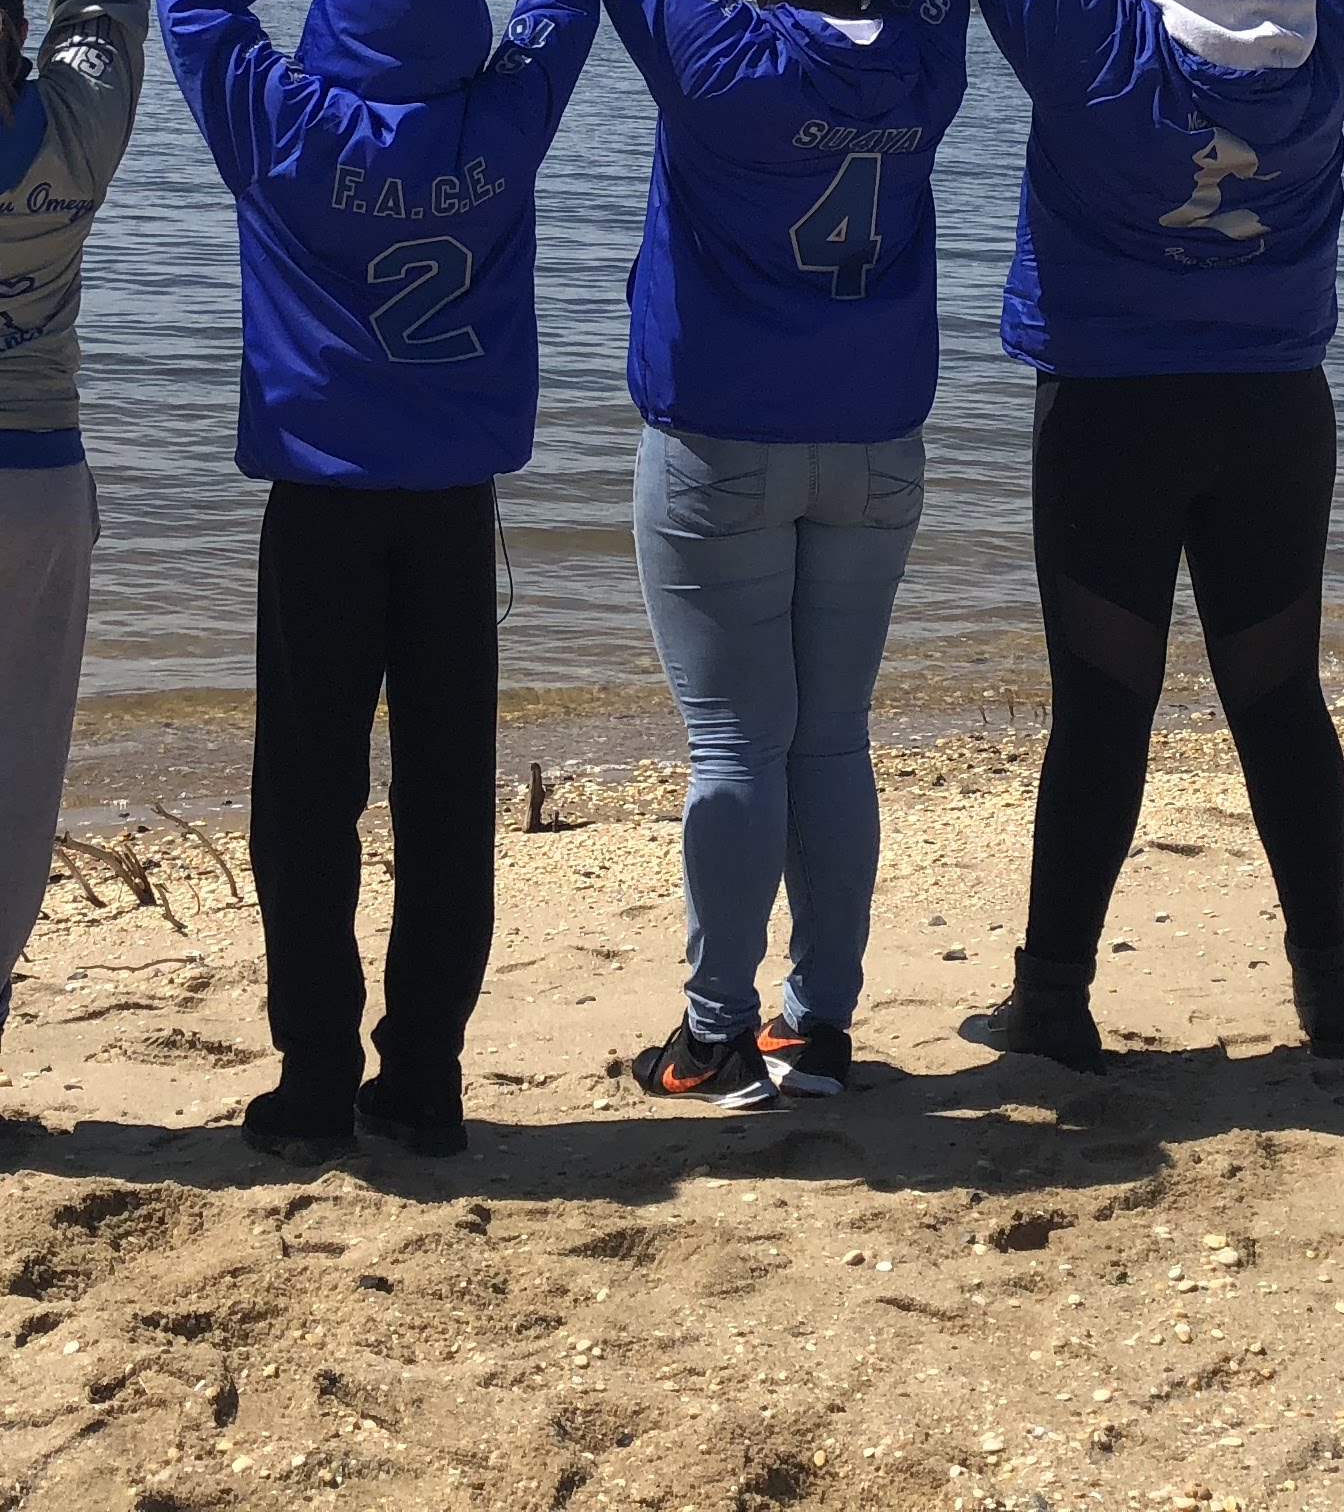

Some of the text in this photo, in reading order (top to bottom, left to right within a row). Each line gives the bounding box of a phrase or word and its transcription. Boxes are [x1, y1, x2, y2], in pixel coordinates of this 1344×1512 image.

[26, 181, 96, 223] Omega
[332, 157, 505, 219] F.A.C.E.
[788, 152, 882, 300] 4
[367, 236, 485, 363] 2
